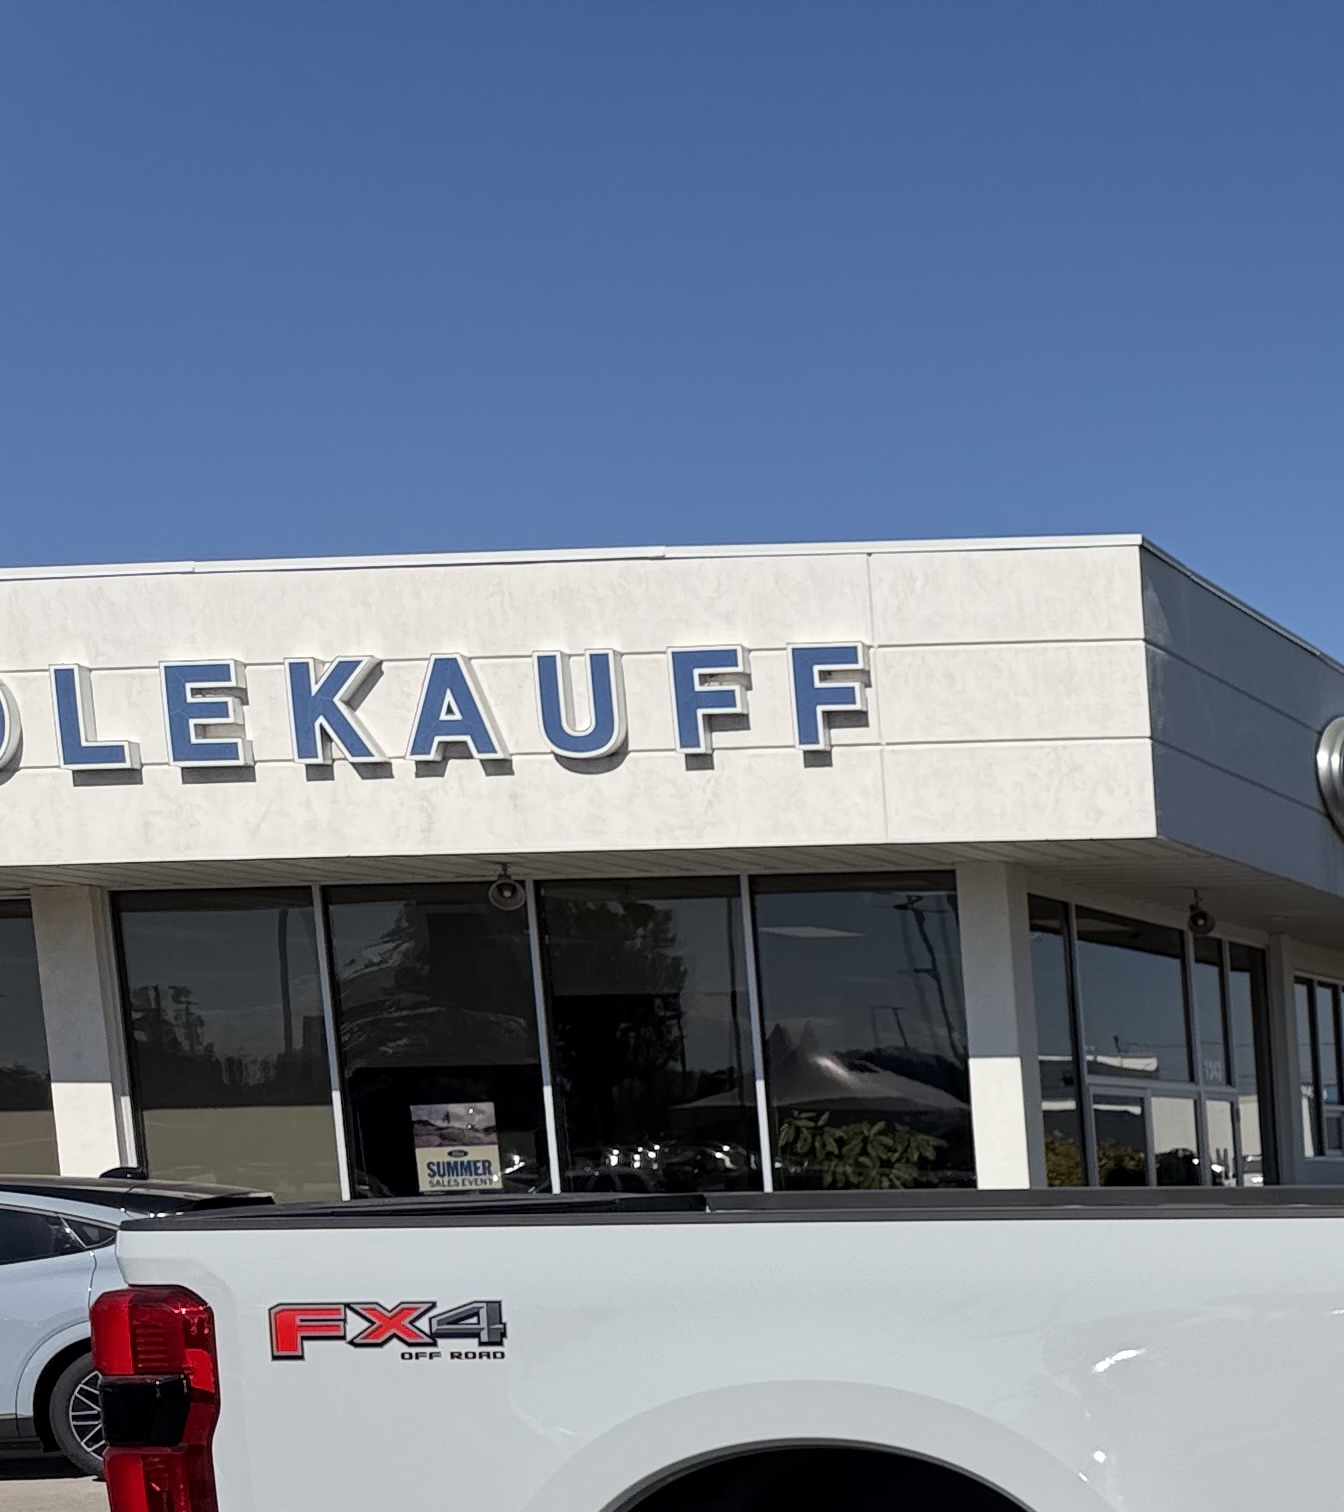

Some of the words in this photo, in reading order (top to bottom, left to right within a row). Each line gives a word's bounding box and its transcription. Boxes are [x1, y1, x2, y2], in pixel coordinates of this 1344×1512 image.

[0, 643, 870, 770] LEKAUFF
[426, 1160, 493, 1178] SUMMER
[428, 1179, 460, 1188] SALES
[461, 1177, 494, 1187] EVENT
[268, 1300, 507, 1361] FX4
[400, 1351, 442, 1361] OFF
[450, 1351, 505, 1361] ROAD
